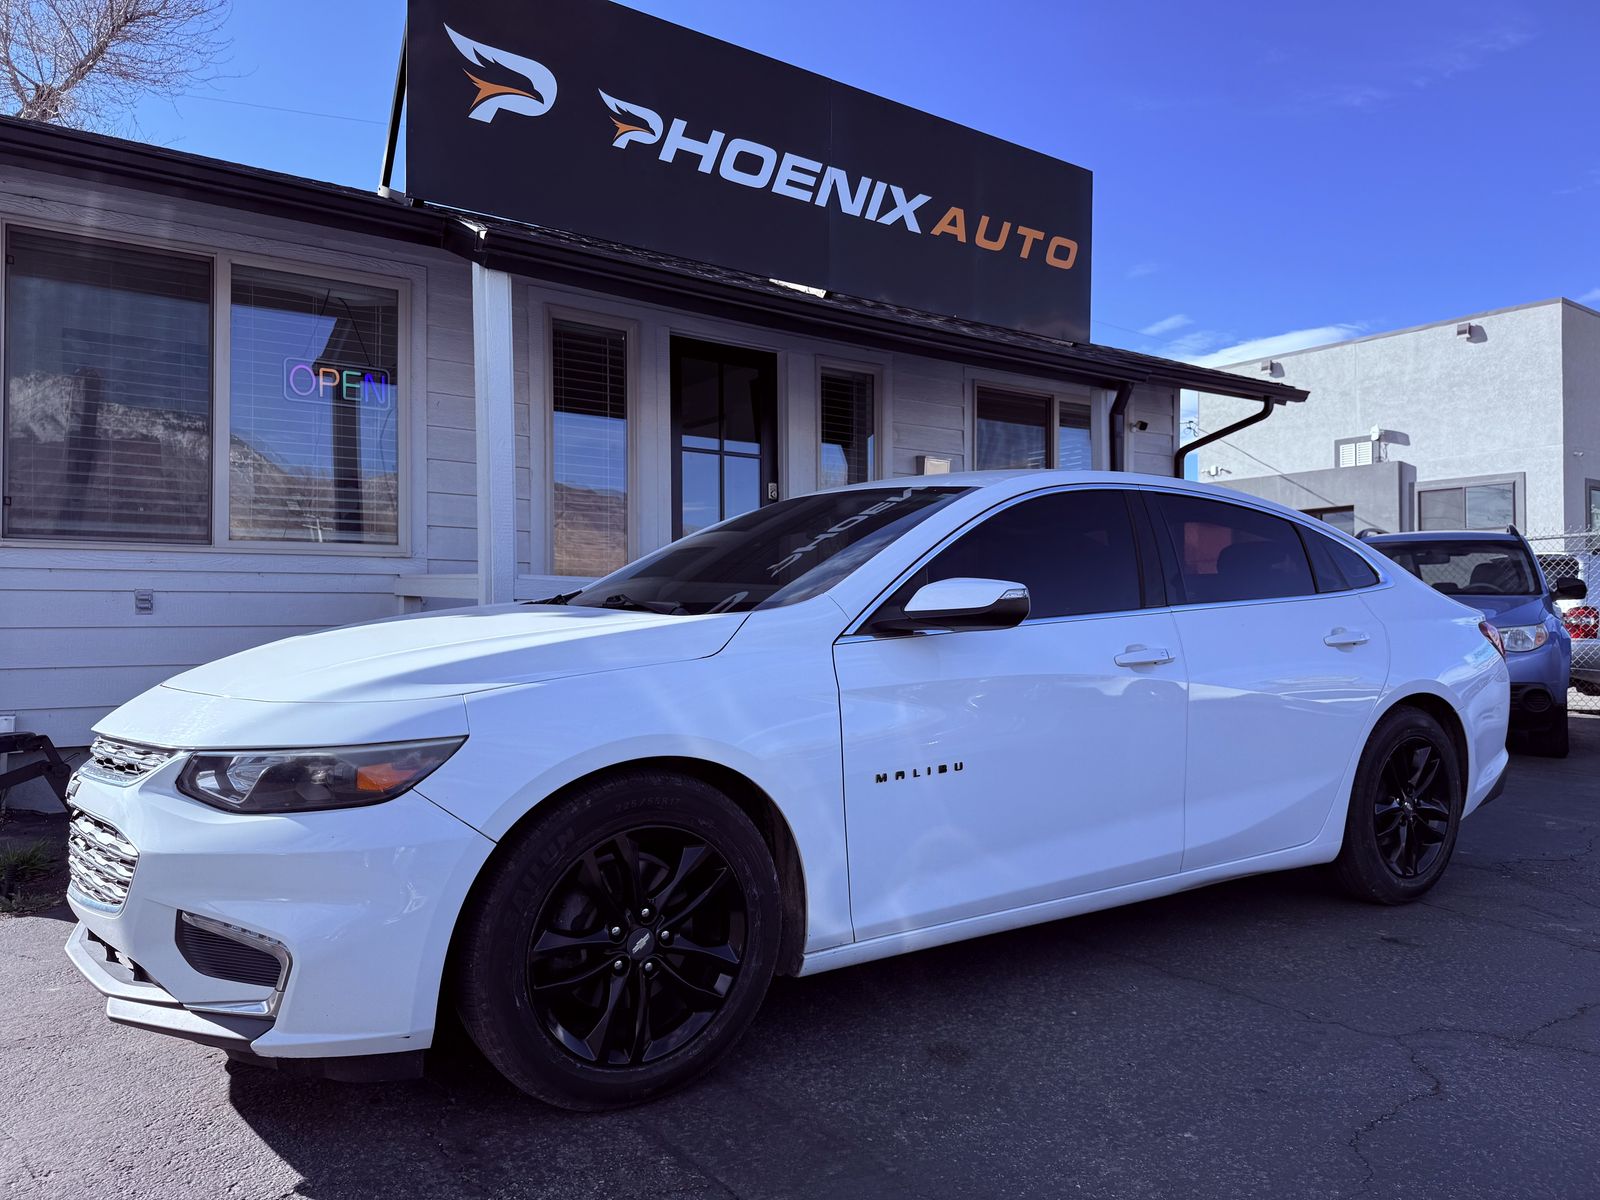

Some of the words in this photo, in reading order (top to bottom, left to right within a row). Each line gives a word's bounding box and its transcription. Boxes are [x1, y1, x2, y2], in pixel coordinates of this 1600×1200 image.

[598, 87, 932, 234] PHOENIX
[930, 206, 1078, 270] AUTO
[289, 364, 386, 404] OPEN
[875, 761, 964, 783] MALIBU
